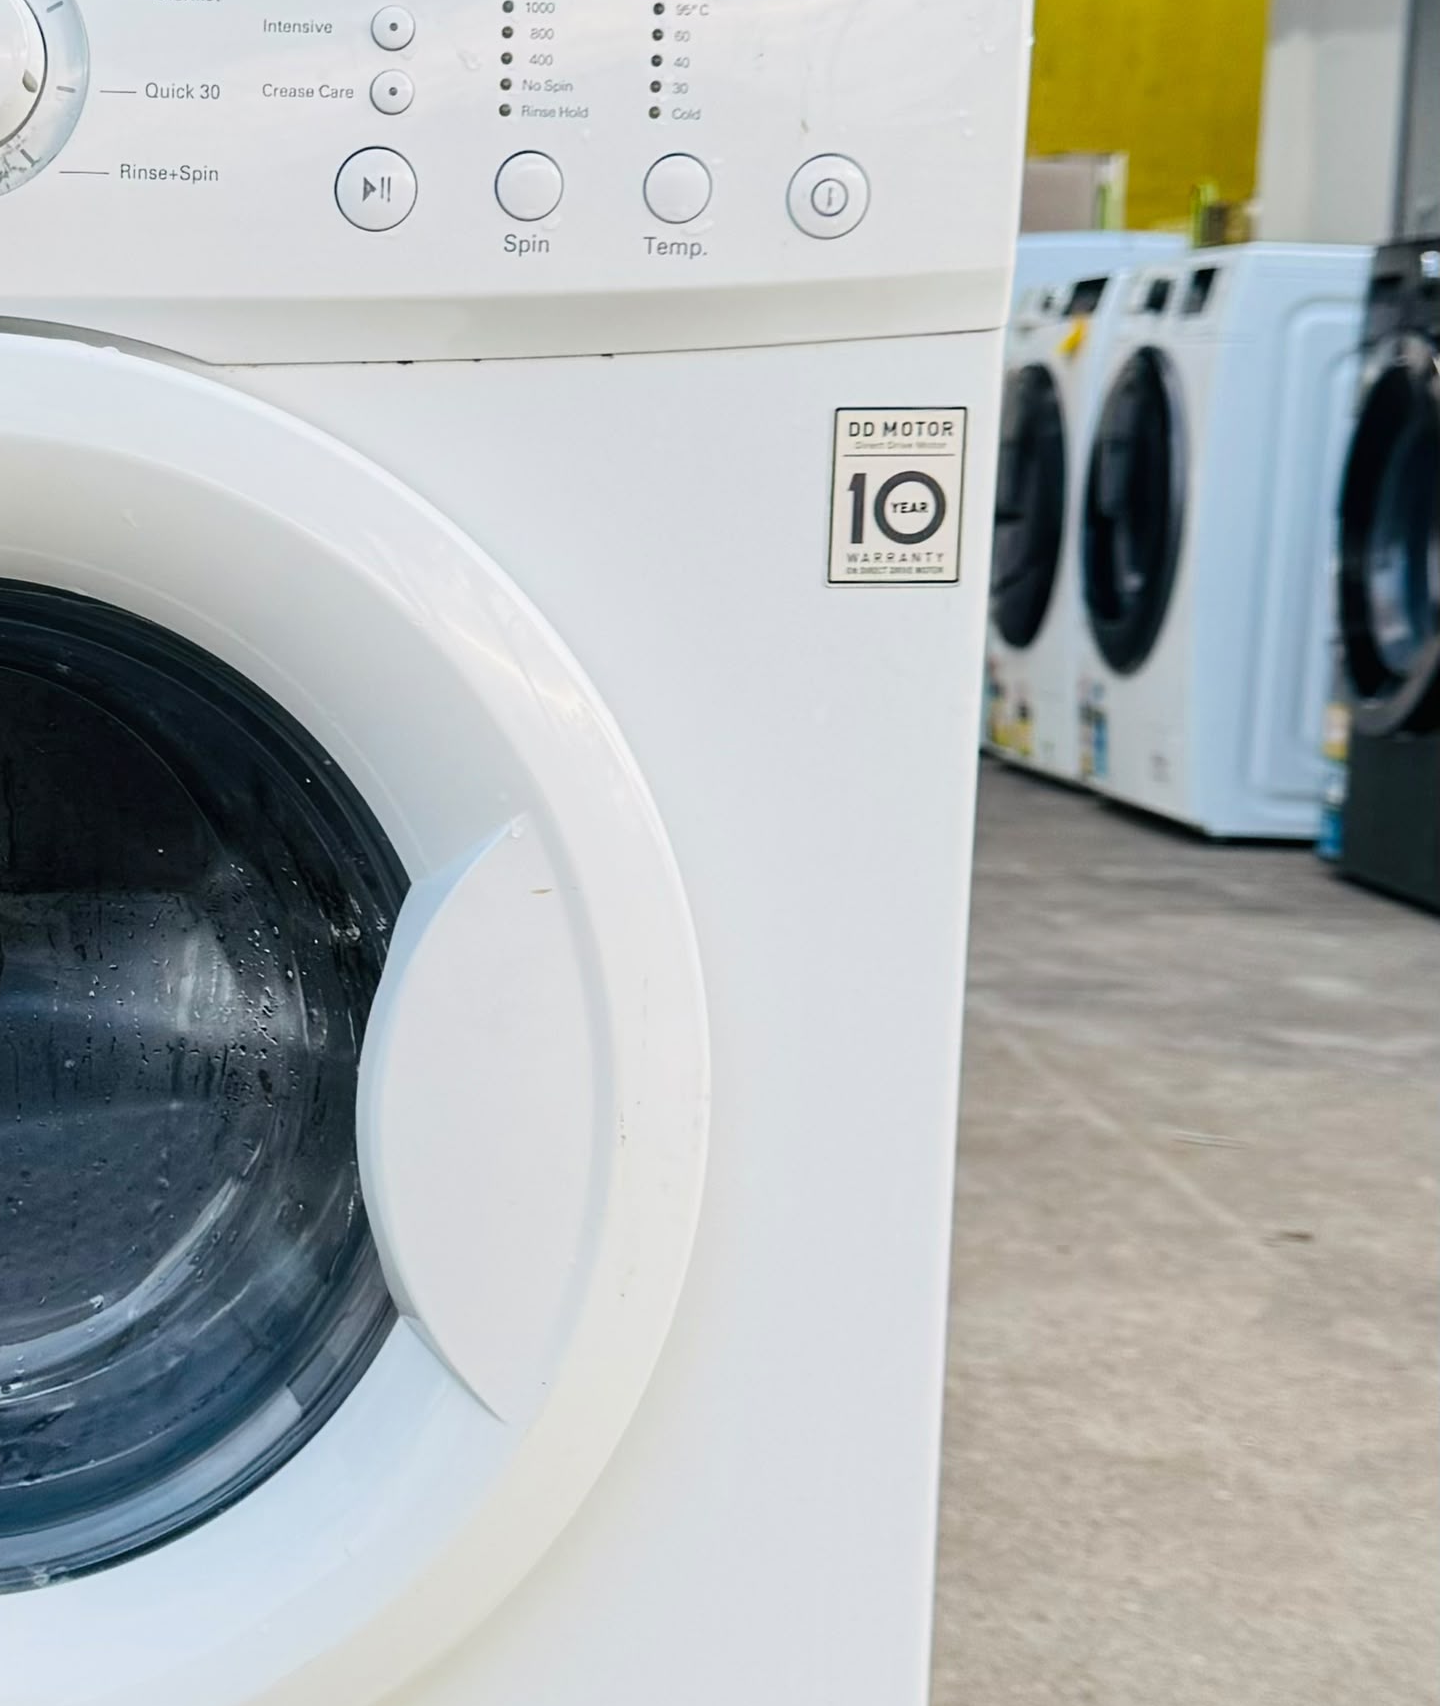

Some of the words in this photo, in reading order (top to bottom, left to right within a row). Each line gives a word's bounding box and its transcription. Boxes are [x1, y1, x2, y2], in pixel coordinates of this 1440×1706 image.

[526, 1, 555, 14] 1000
[263, 19, 333, 34] Intensive
[529, 54, 553, 66] 400
[145, 82, 195, 100] Quick
[200, 84, 221, 100] 30
[262, 83, 315, 99] Crease
[319, 84, 354, 99] Care
[521, 79, 541, 92] No
[544, 79, 574, 93] Spin
[671, 82, 690, 95] 30
[521, 105, 556, 118] Rinse
[559, 106, 589, 119] Hold
[671, 108, 701, 120] Cold
[120, 163, 219, 184] Rinse+Spin
[503, 233, 550, 257] Spin
[643, 236, 709, 260] Temp.
[849, 421, 875, 437] DD
[882, 421, 953, 437] MOTOR
[847, 470, 947, 545] 10
[891, 501, 929, 514] YEAR
[846, 552, 945, 563] WARRANTY
